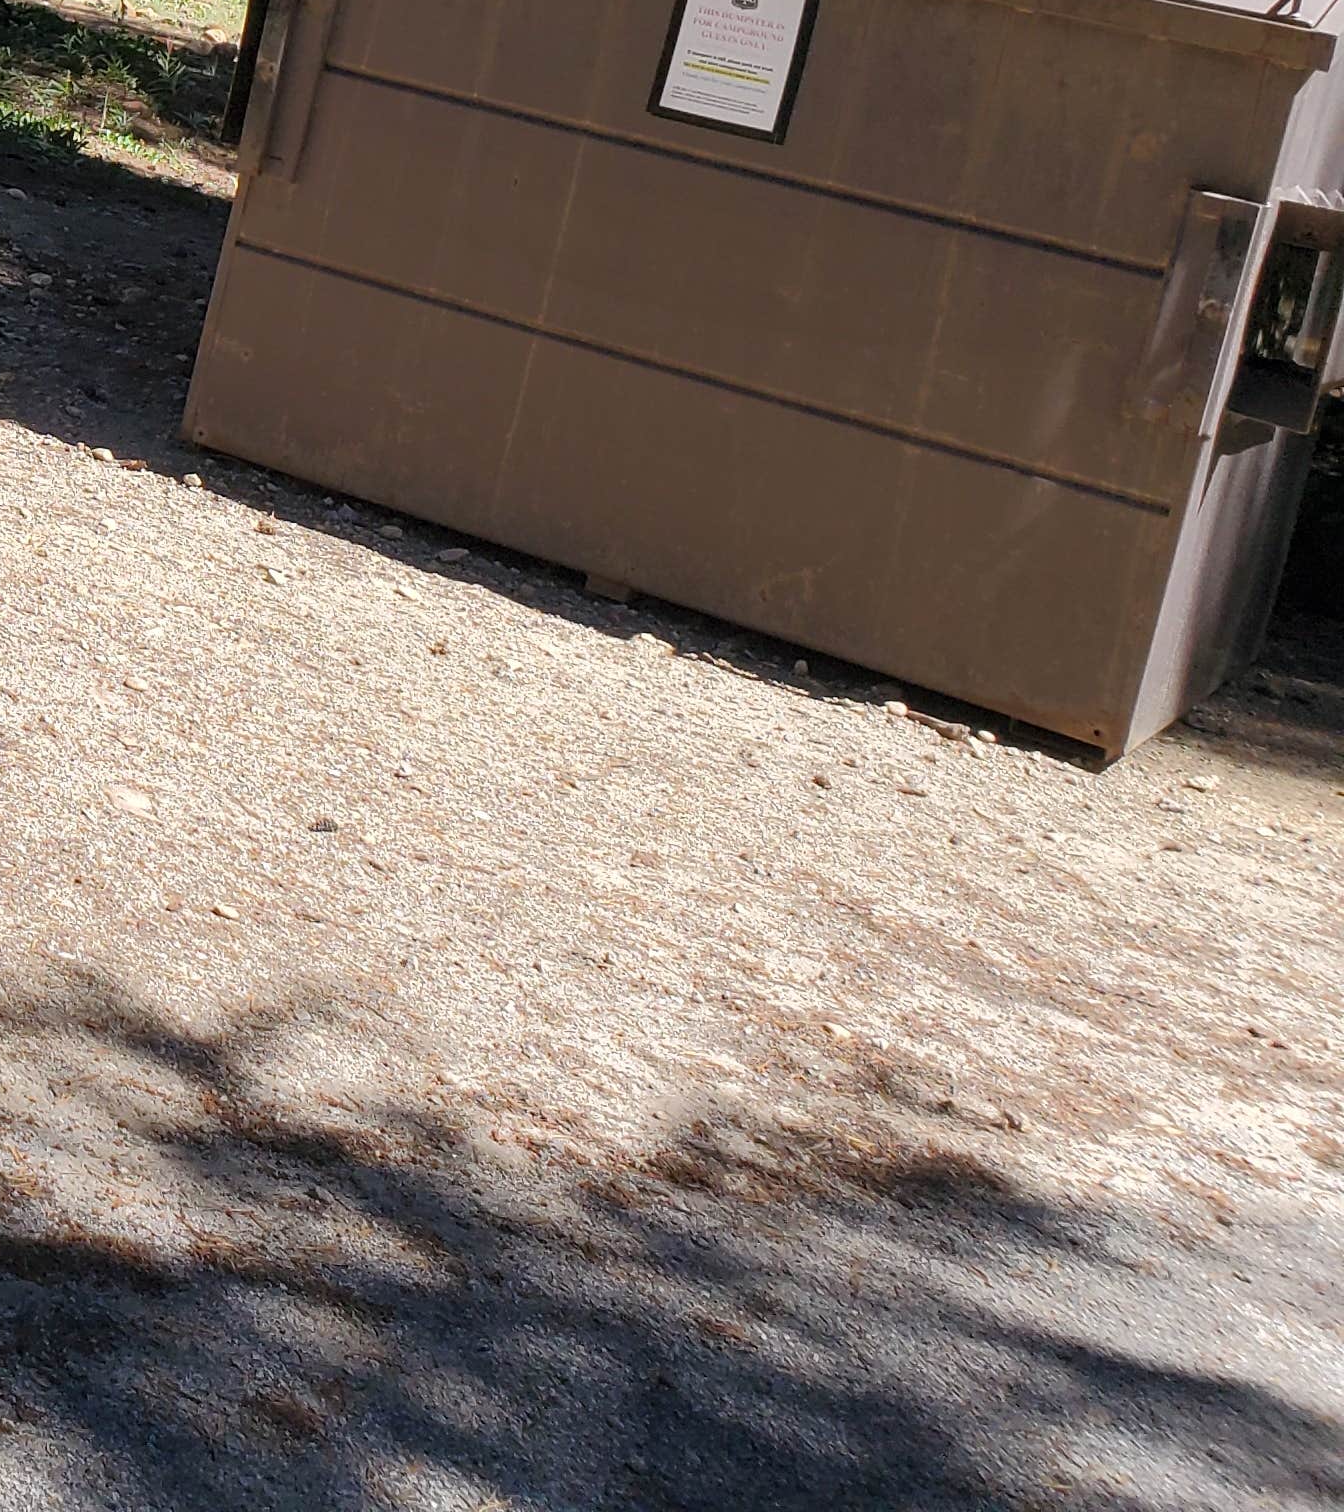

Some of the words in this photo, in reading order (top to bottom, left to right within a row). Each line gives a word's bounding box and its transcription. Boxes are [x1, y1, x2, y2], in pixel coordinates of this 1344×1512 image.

[698, 7, 720, 18] THIS
[721, 11, 773, 29] DUMPSTER
[693, 17, 712, 28] FOR
[714, 20, 784, 42] CAMPGROUND
[701, 30, 738, 44] GUESTS
[740, 39, 766, 50] ONLY
